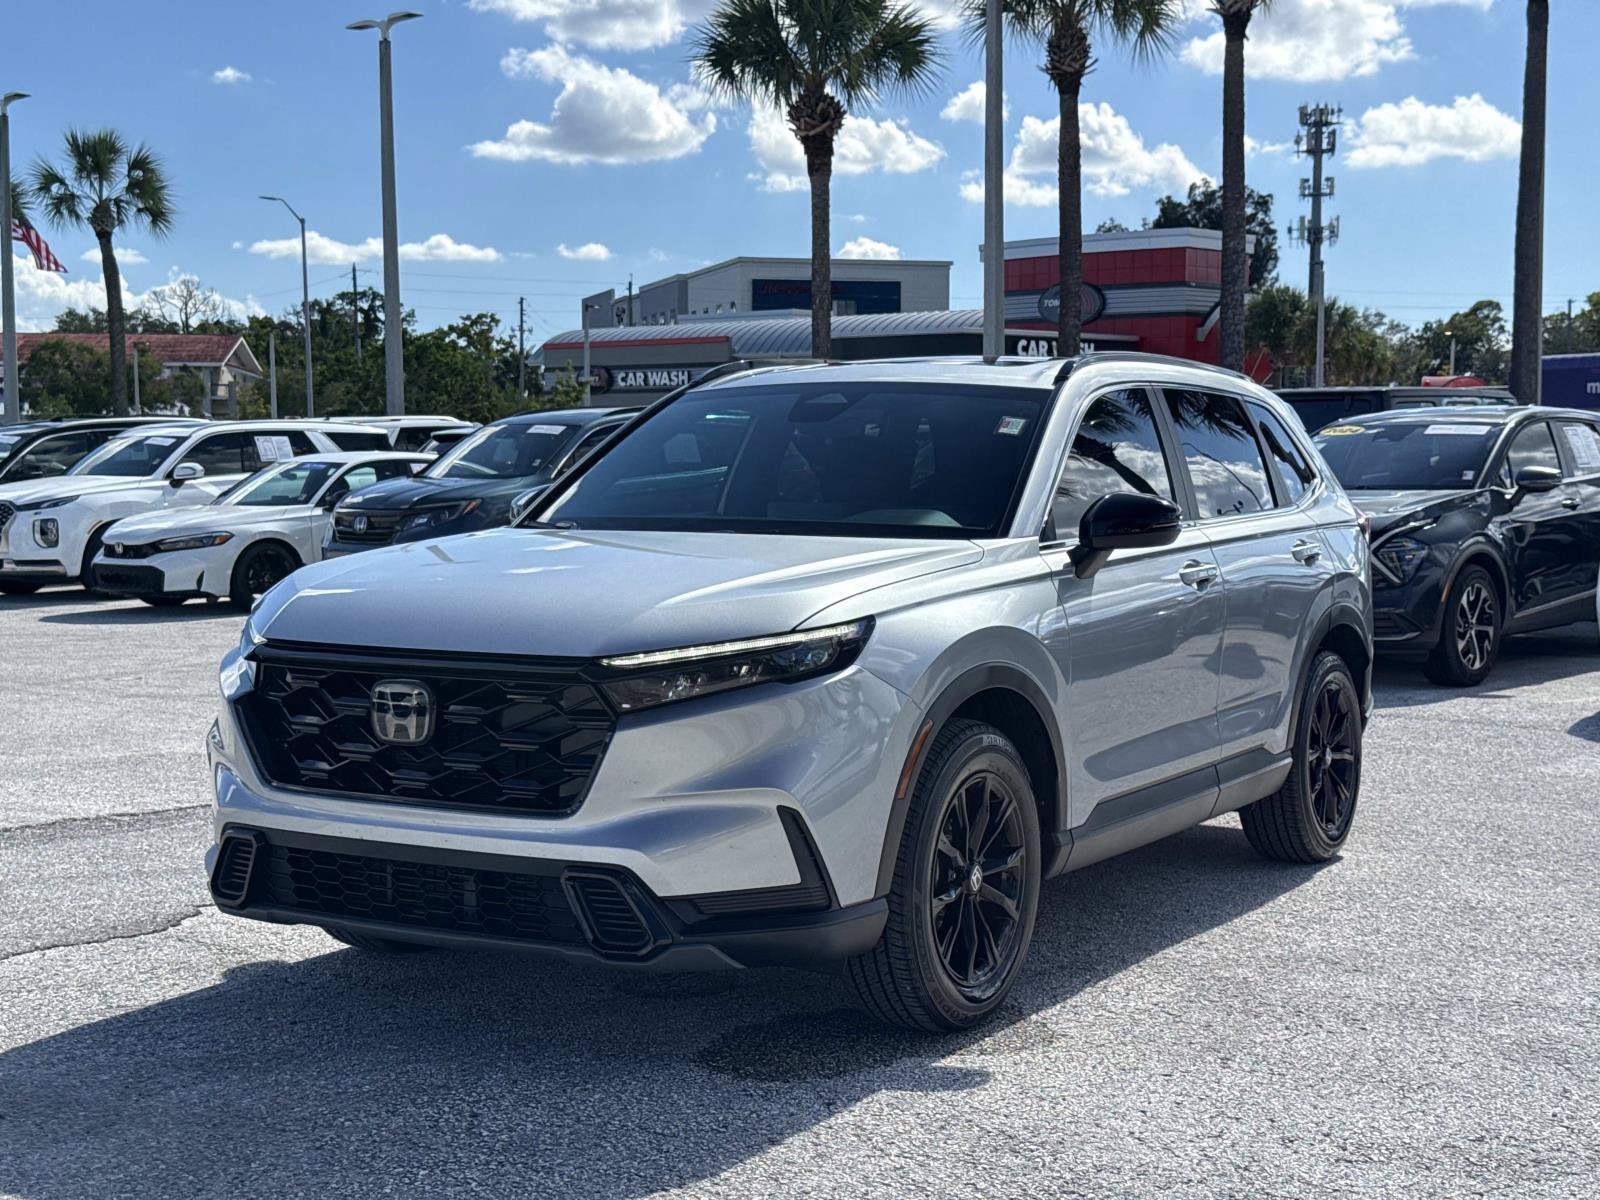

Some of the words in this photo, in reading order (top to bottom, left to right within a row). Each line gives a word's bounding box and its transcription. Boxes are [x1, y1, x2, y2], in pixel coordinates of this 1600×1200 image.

[1017, 339, 1048, 357] CAR
[618, 372, 645, 386] CAR
[648, 371, 689, 385] WASH
